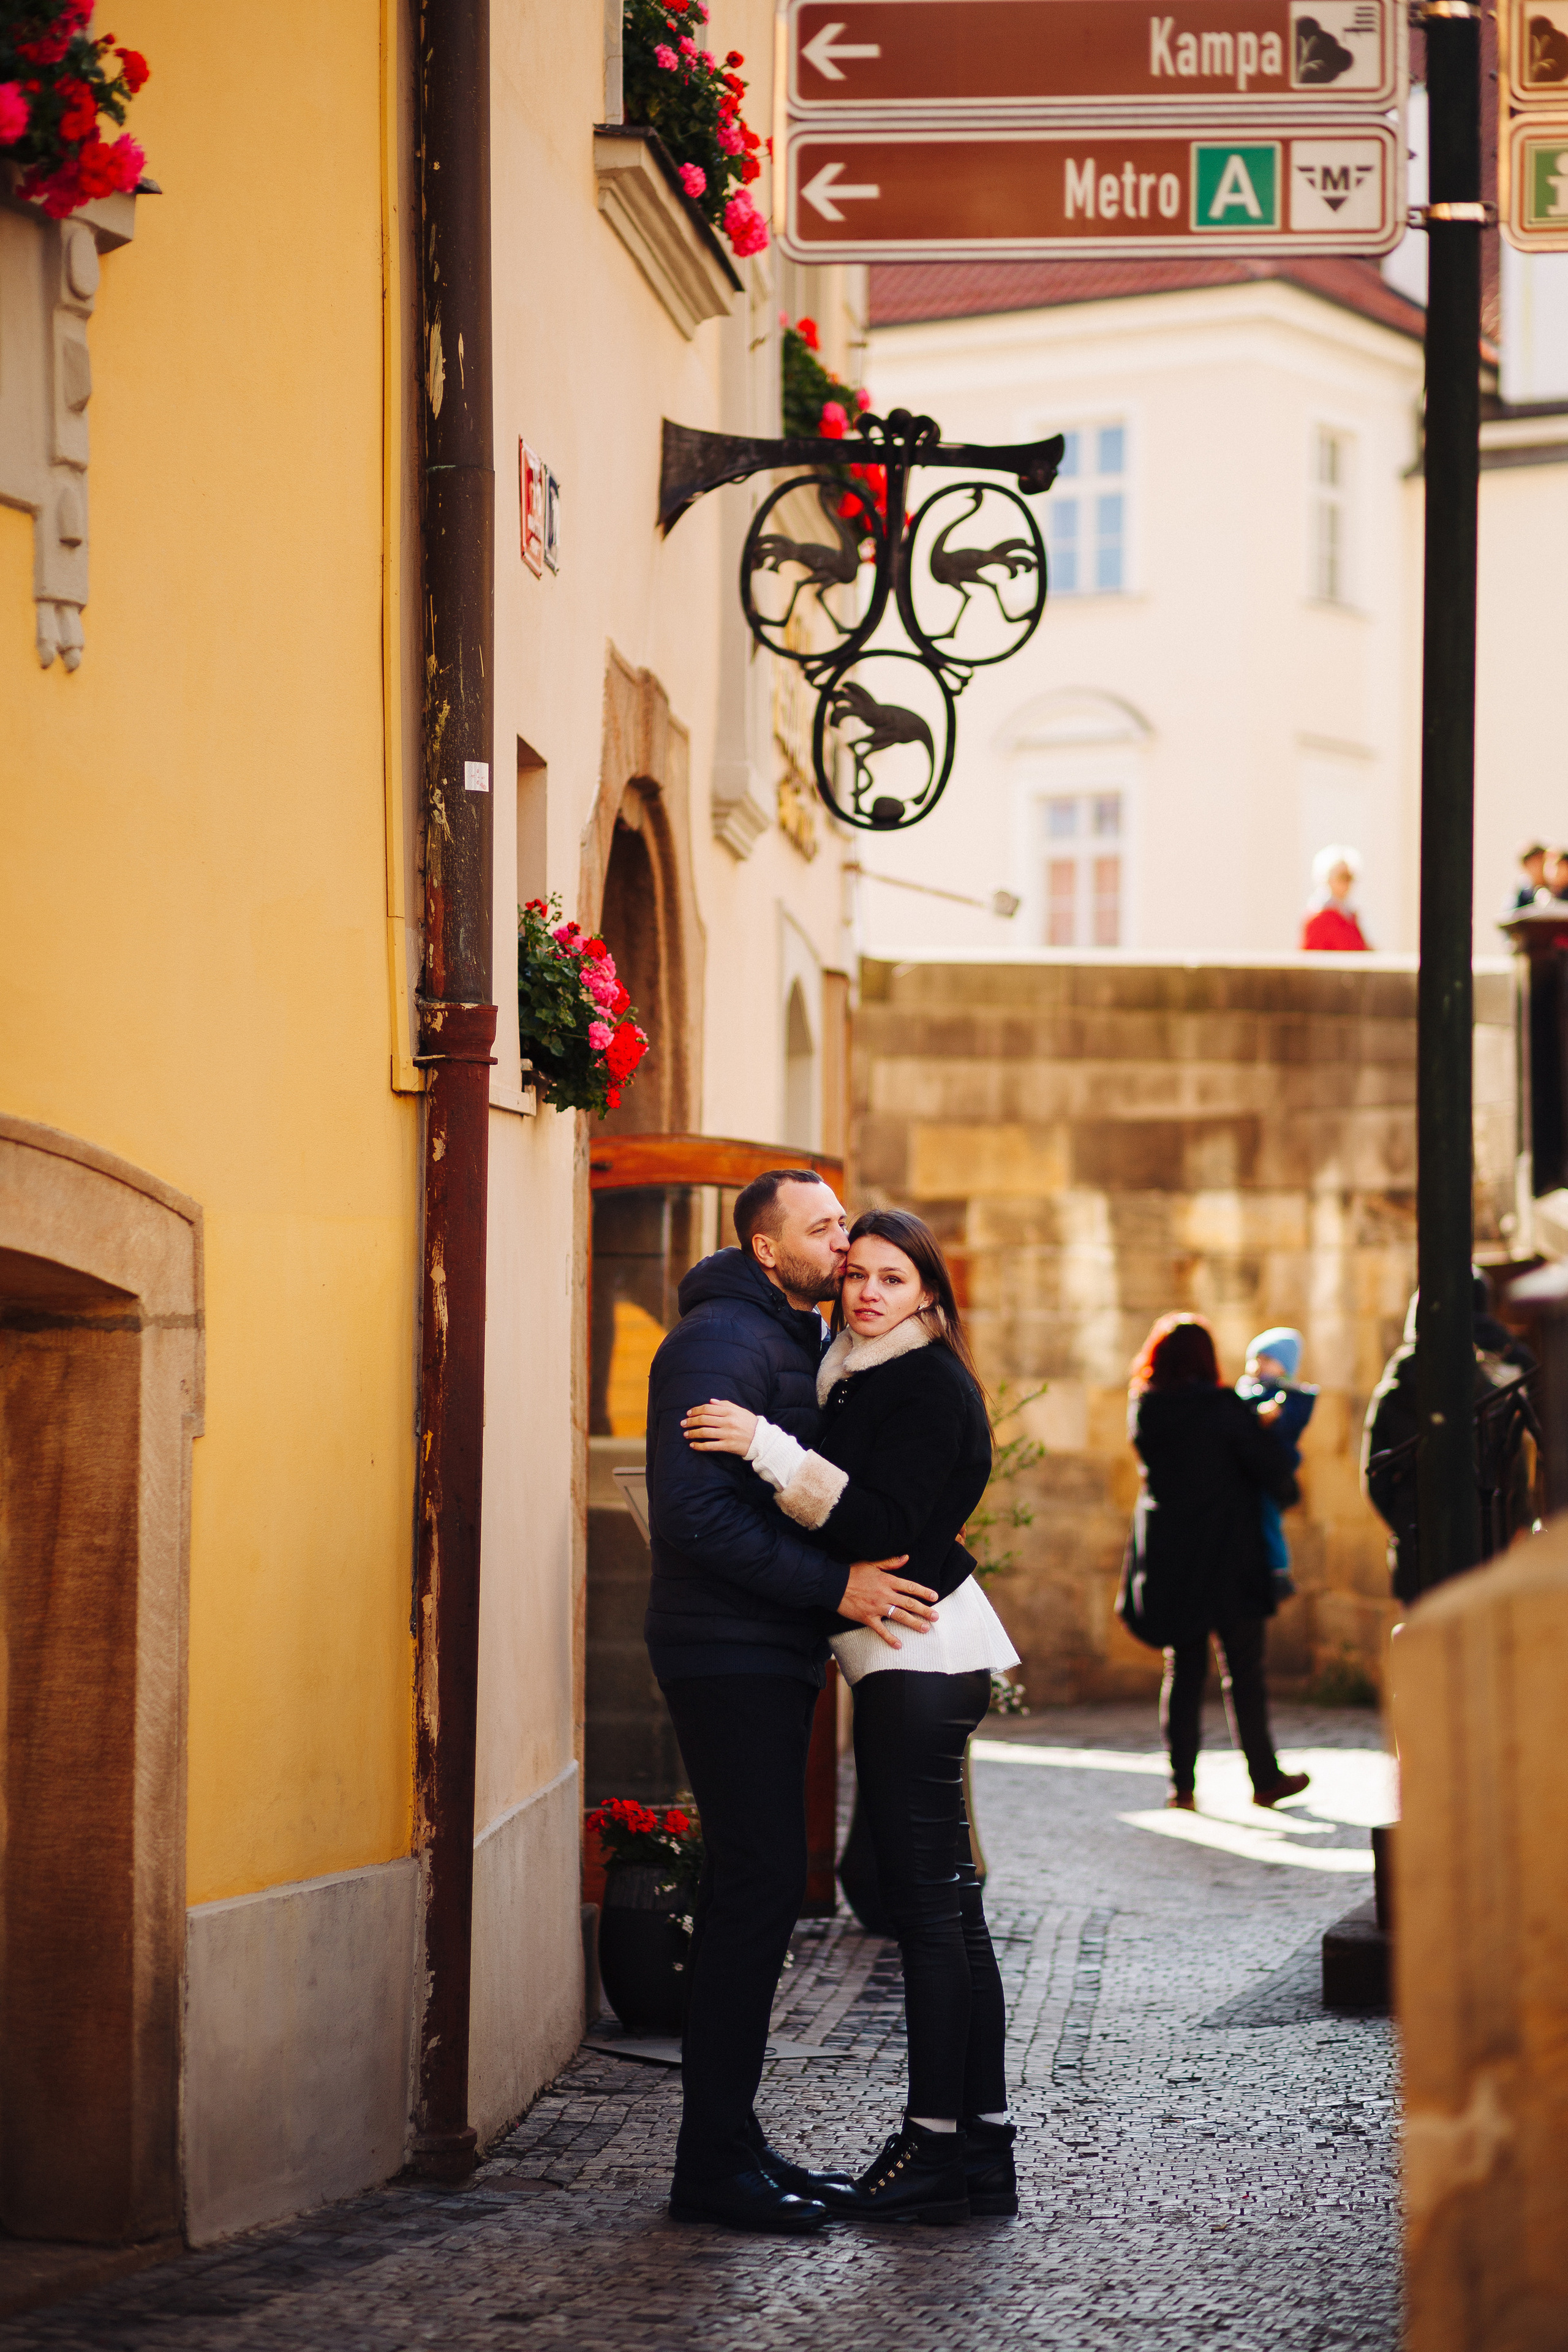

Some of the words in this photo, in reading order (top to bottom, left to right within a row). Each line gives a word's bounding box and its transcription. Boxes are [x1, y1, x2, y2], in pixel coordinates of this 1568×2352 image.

[1150, 16, 1283, 92] Kampa
[1064, 157, 1180, 220] Metro
[1208, 154, 1263, 220] A
[1321, 165, 1351, 191] M
